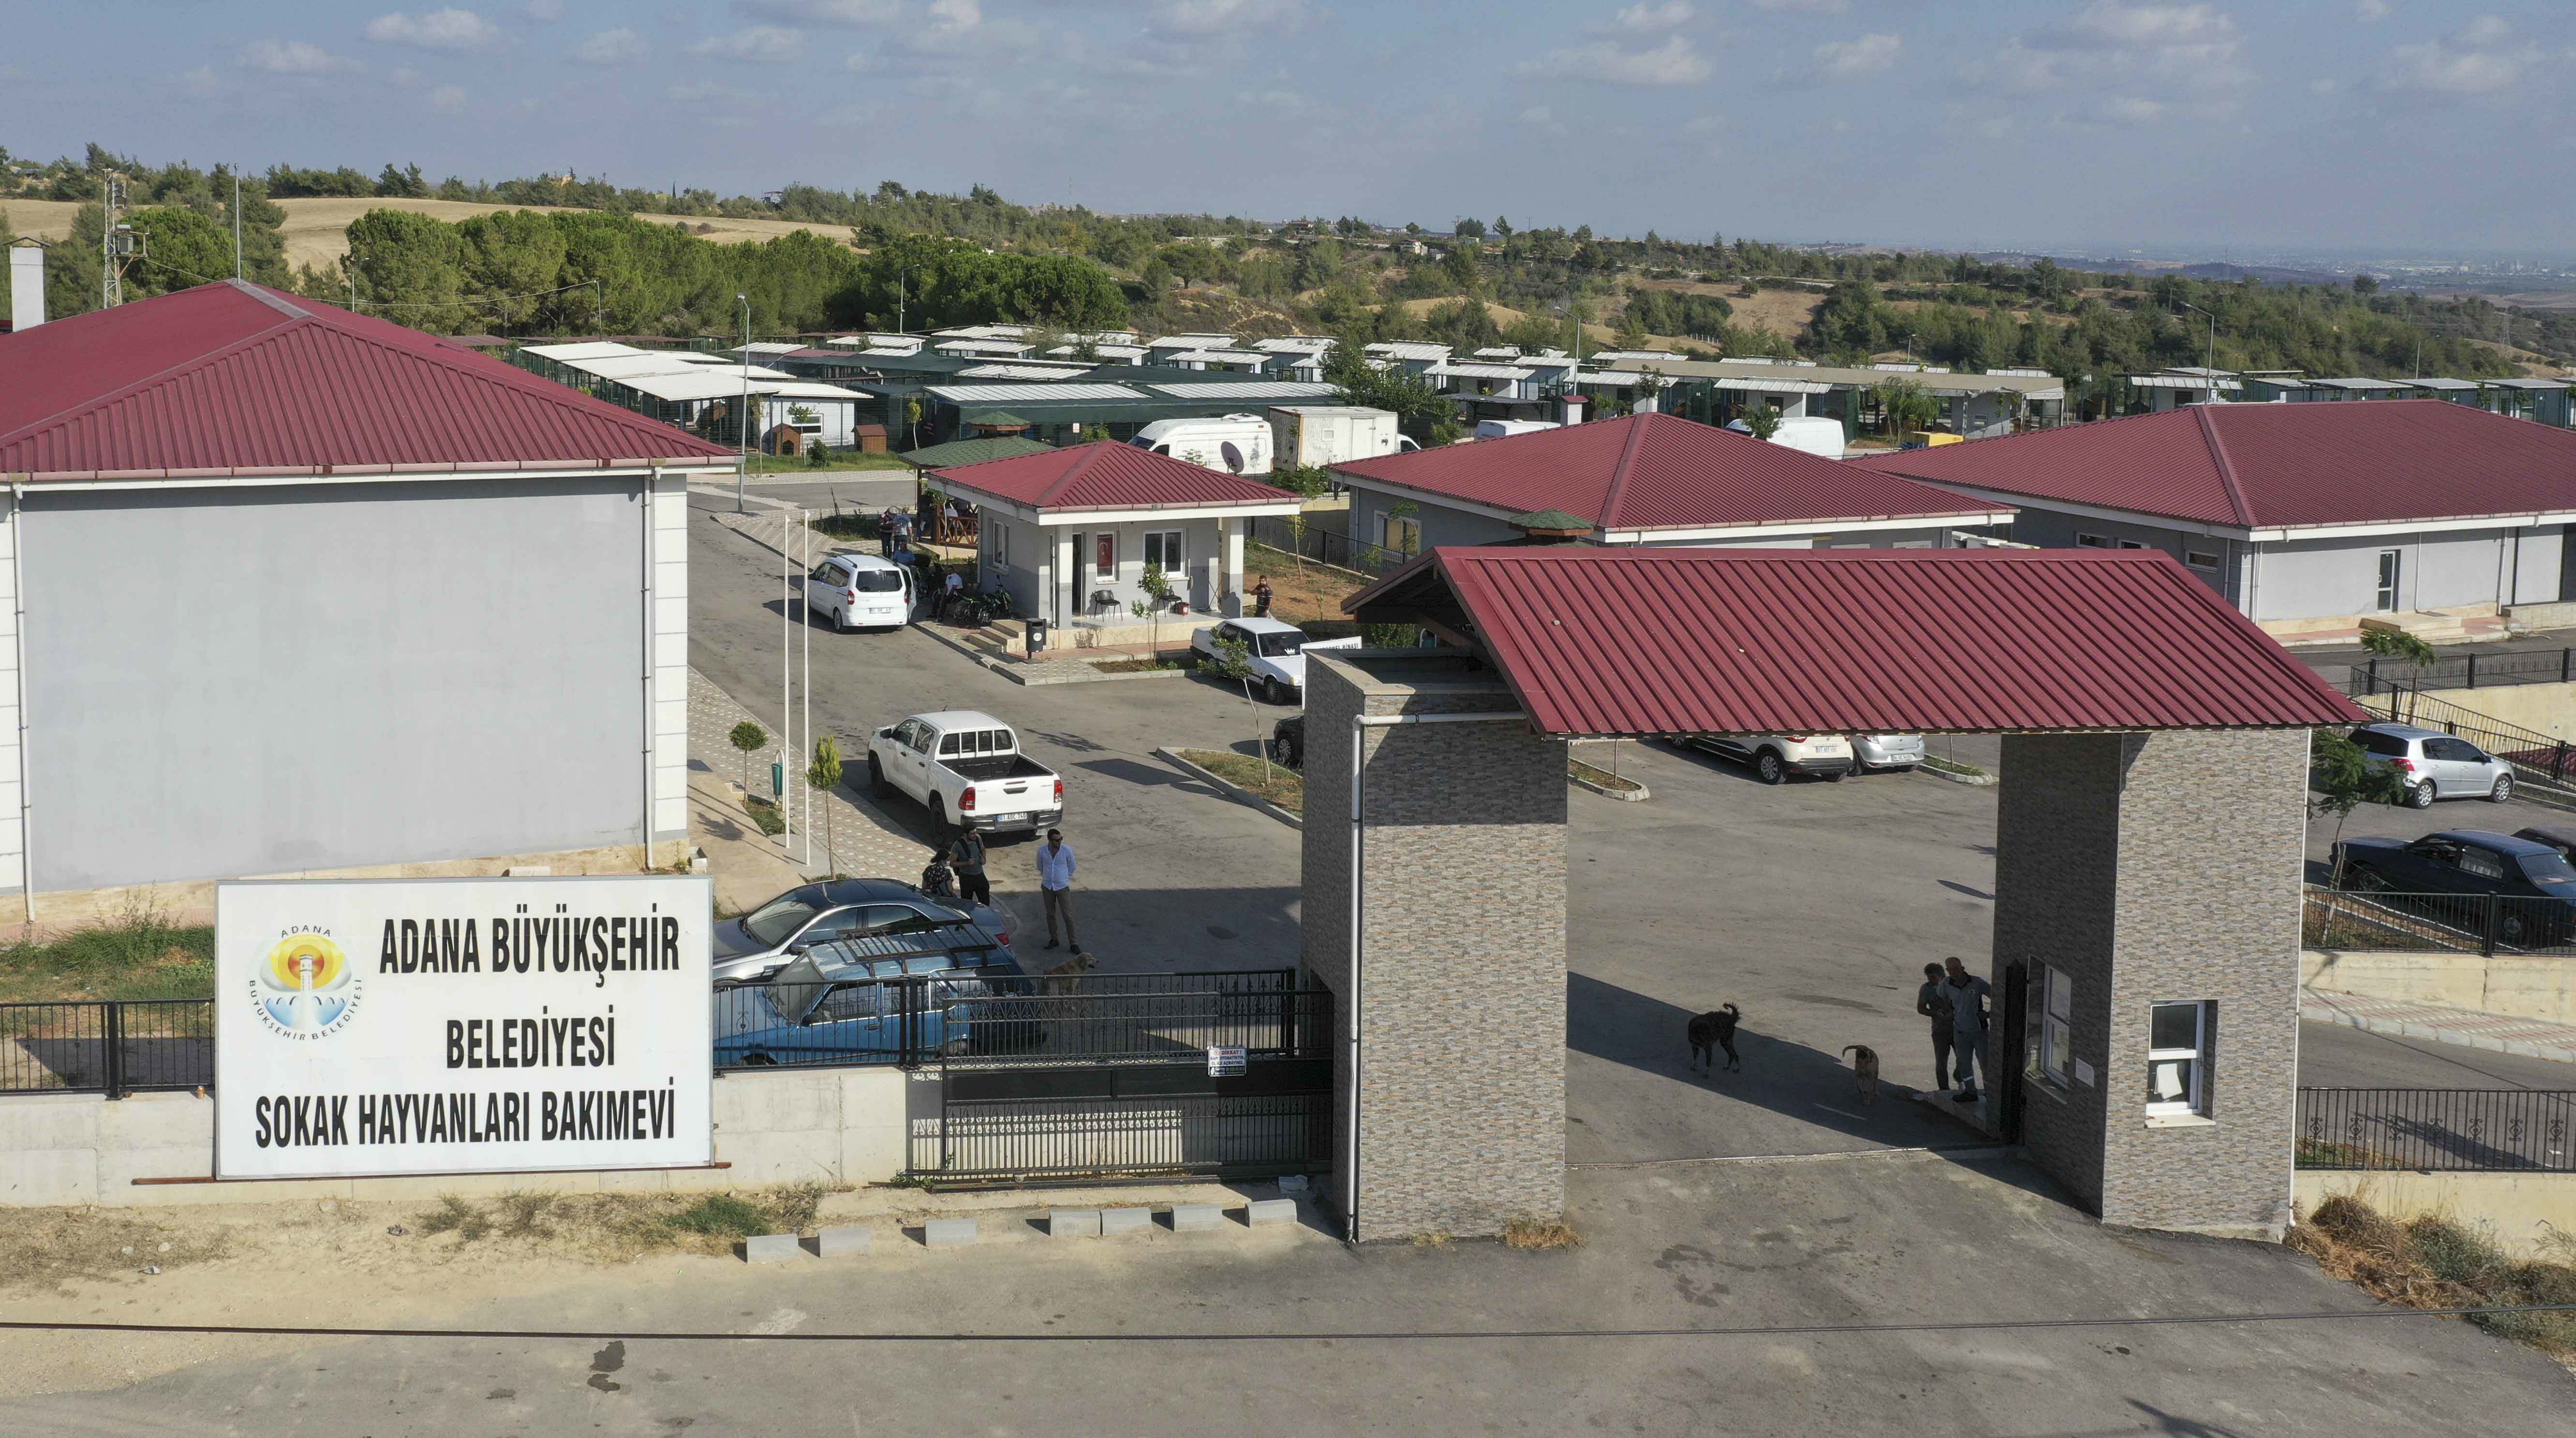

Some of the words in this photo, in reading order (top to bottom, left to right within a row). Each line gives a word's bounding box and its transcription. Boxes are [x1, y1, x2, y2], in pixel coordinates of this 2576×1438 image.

[281, 925, 330, 937] ADANA
[380, 919, 480, 973] ADANA
[493, 904, 679, 988] BÜYÜKŞEHİR
[447, 1005, 614, 1068] BELEDİYESİ
[256, 1096, 348, 1148] SOKAK
[359, 1092, 529, 1144] HAYVANLARI
[543, 1077, 674, 1141] BAKIMEVİ
